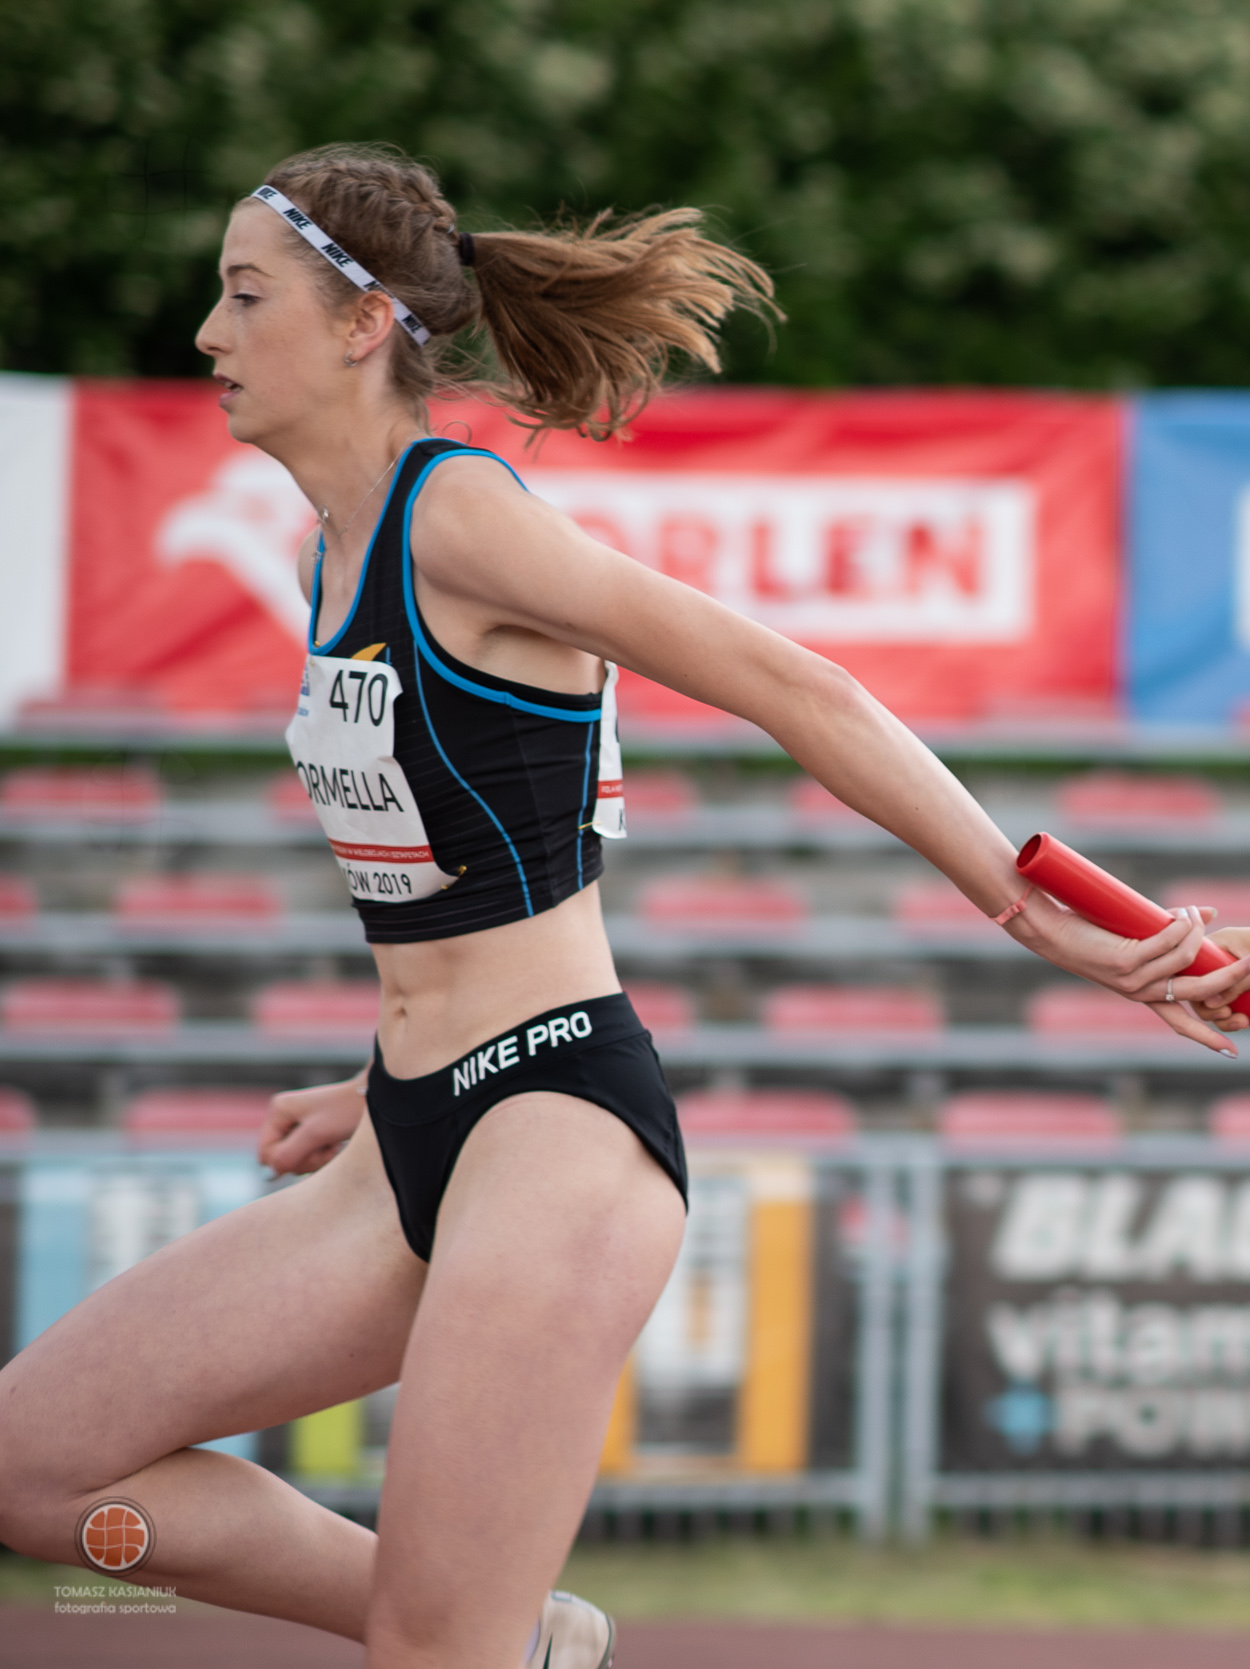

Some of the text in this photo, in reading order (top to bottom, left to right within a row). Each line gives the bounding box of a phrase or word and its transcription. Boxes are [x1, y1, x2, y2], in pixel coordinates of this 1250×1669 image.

[283, 207, 313, 231] NIKE
[321, 242, 353, 268] NIKE
[329, 669, 389, 727] 470
[342, 863, 413, 895] ÓW 2019
[452, 1011, 593, 1097] NIKE PRO
